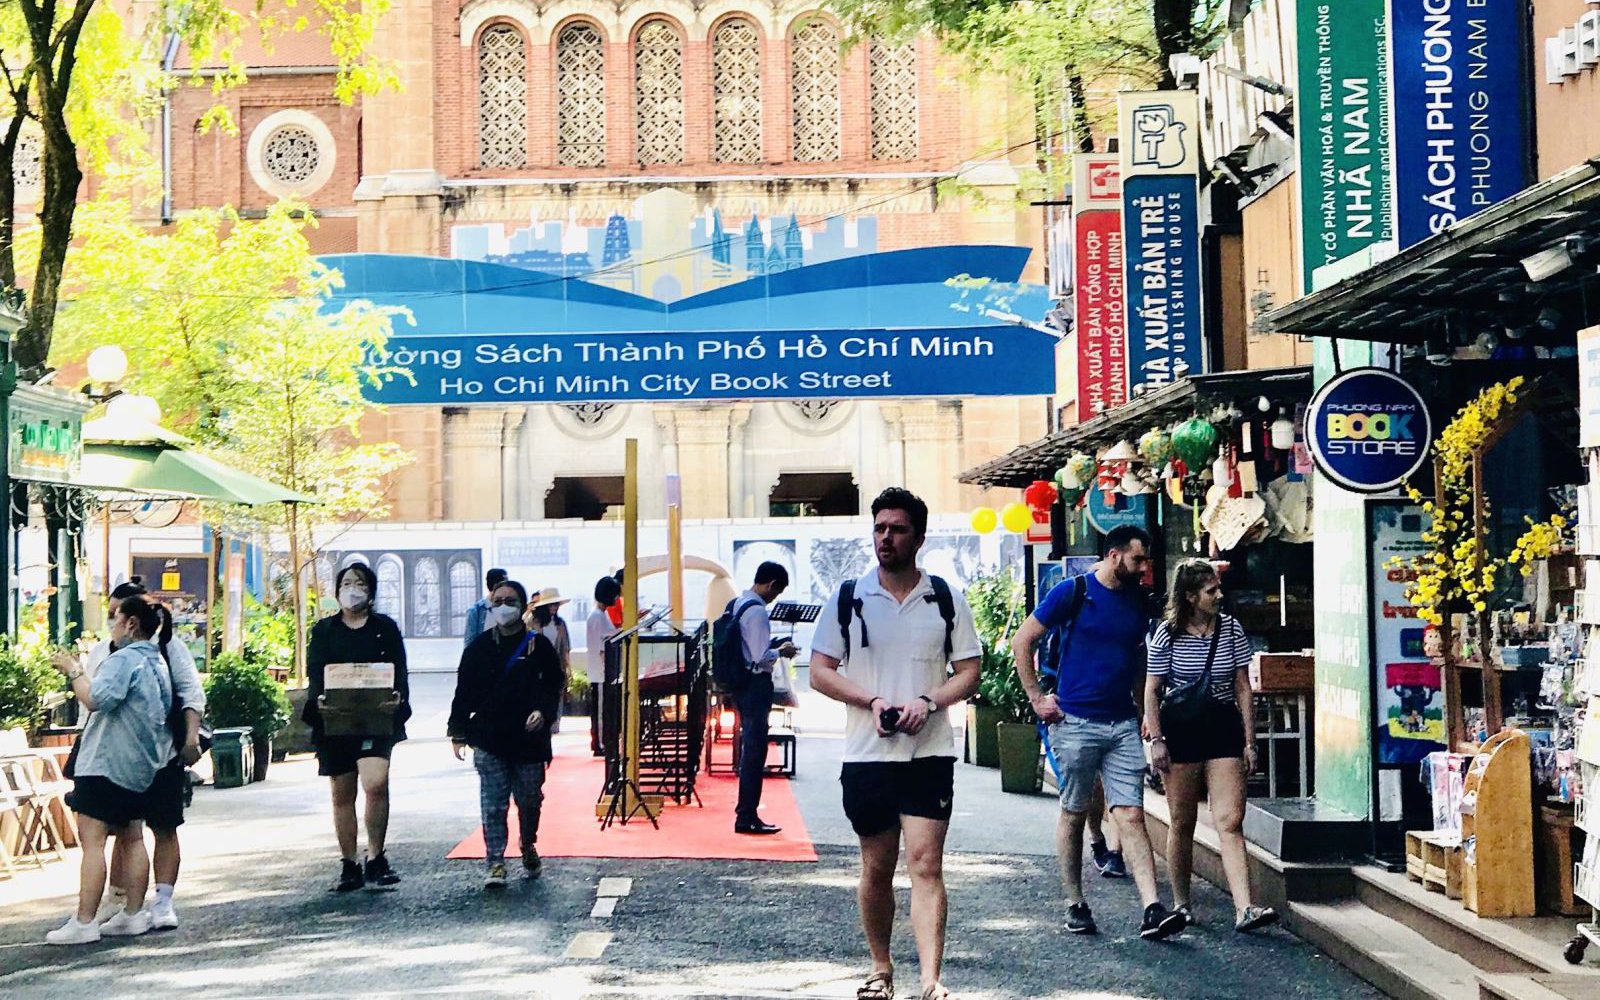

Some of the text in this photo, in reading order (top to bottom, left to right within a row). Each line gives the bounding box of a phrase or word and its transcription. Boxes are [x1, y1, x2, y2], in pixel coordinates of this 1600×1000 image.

[1315, 5, 1331, 53] THÔNG
[1466, 19, 1488, 79] NAM
[1316, 57, 1333, 109] TRUYỀN
[1376, 41, 1390, 144] Communications
[1320, 112, 1333, 122] &
[1421, 0, 1456, 234] SÁCH PHƯƠNG
[1319, 125, 1334, 155] HOÁ
[1338, 78, 1373, 237] NHÃ NAM
[1468, 91, 1491, 205] PHUONG
[1320, 159, 1335, 187] VĂN
[1377, 148, 1391, 171] and
[1320, 190, 1336, 228] PHẦN
[1378, 175, 1393, 238] Publishing
[1087, 230, 1103, 260] HỢP
[1107, 232, 1121, 269] MINH
[1320, 232, 1337, 250] CỔ
[1081, 263, 1102, 304] TỔNG
[1105, 272, 1122, 297] CHÍ
[1132, 196, 1170, 394] HÀ XUẤT BẢN TRẺ
[1168, 192, 1186, 366] PUBLISHING HOUSE
[1084, 307, 1102, 337] BẢN
[1104, 299, 1122, 322] HỒ
[362, 334, 994, 369] ường Sách Thành Phố Hồ Chí Minh
[1105, 325, 1123, 357] PHỐ
[1084, 343, 1103, 378] XUẤT
[440, 371, 892, 396] Ho Chi Minh City Book Street
[1327, 403, 1416, 412] PHUONG NAM
[1327, 412, 1414, 440] BOOK
[1327, 440, 1416, 455] STORE
